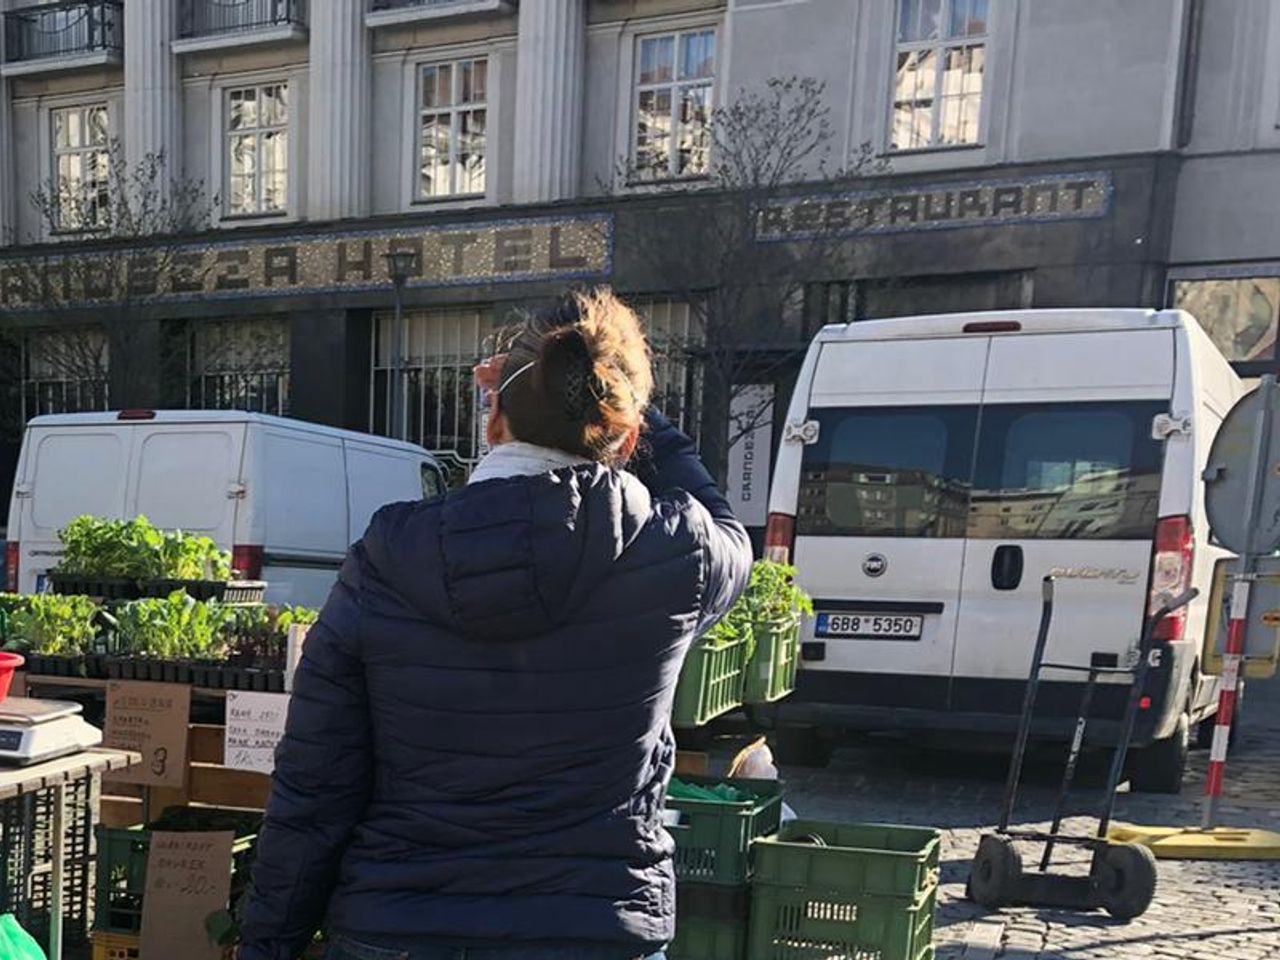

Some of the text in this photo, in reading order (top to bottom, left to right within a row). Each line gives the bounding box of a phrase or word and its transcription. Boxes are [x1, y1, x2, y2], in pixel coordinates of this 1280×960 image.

[762, 181, 1096, 233] RESTAURANT
[337, 226, 588, 282] HOTEL
[831, 617, 914, 633] 6B8 5350
